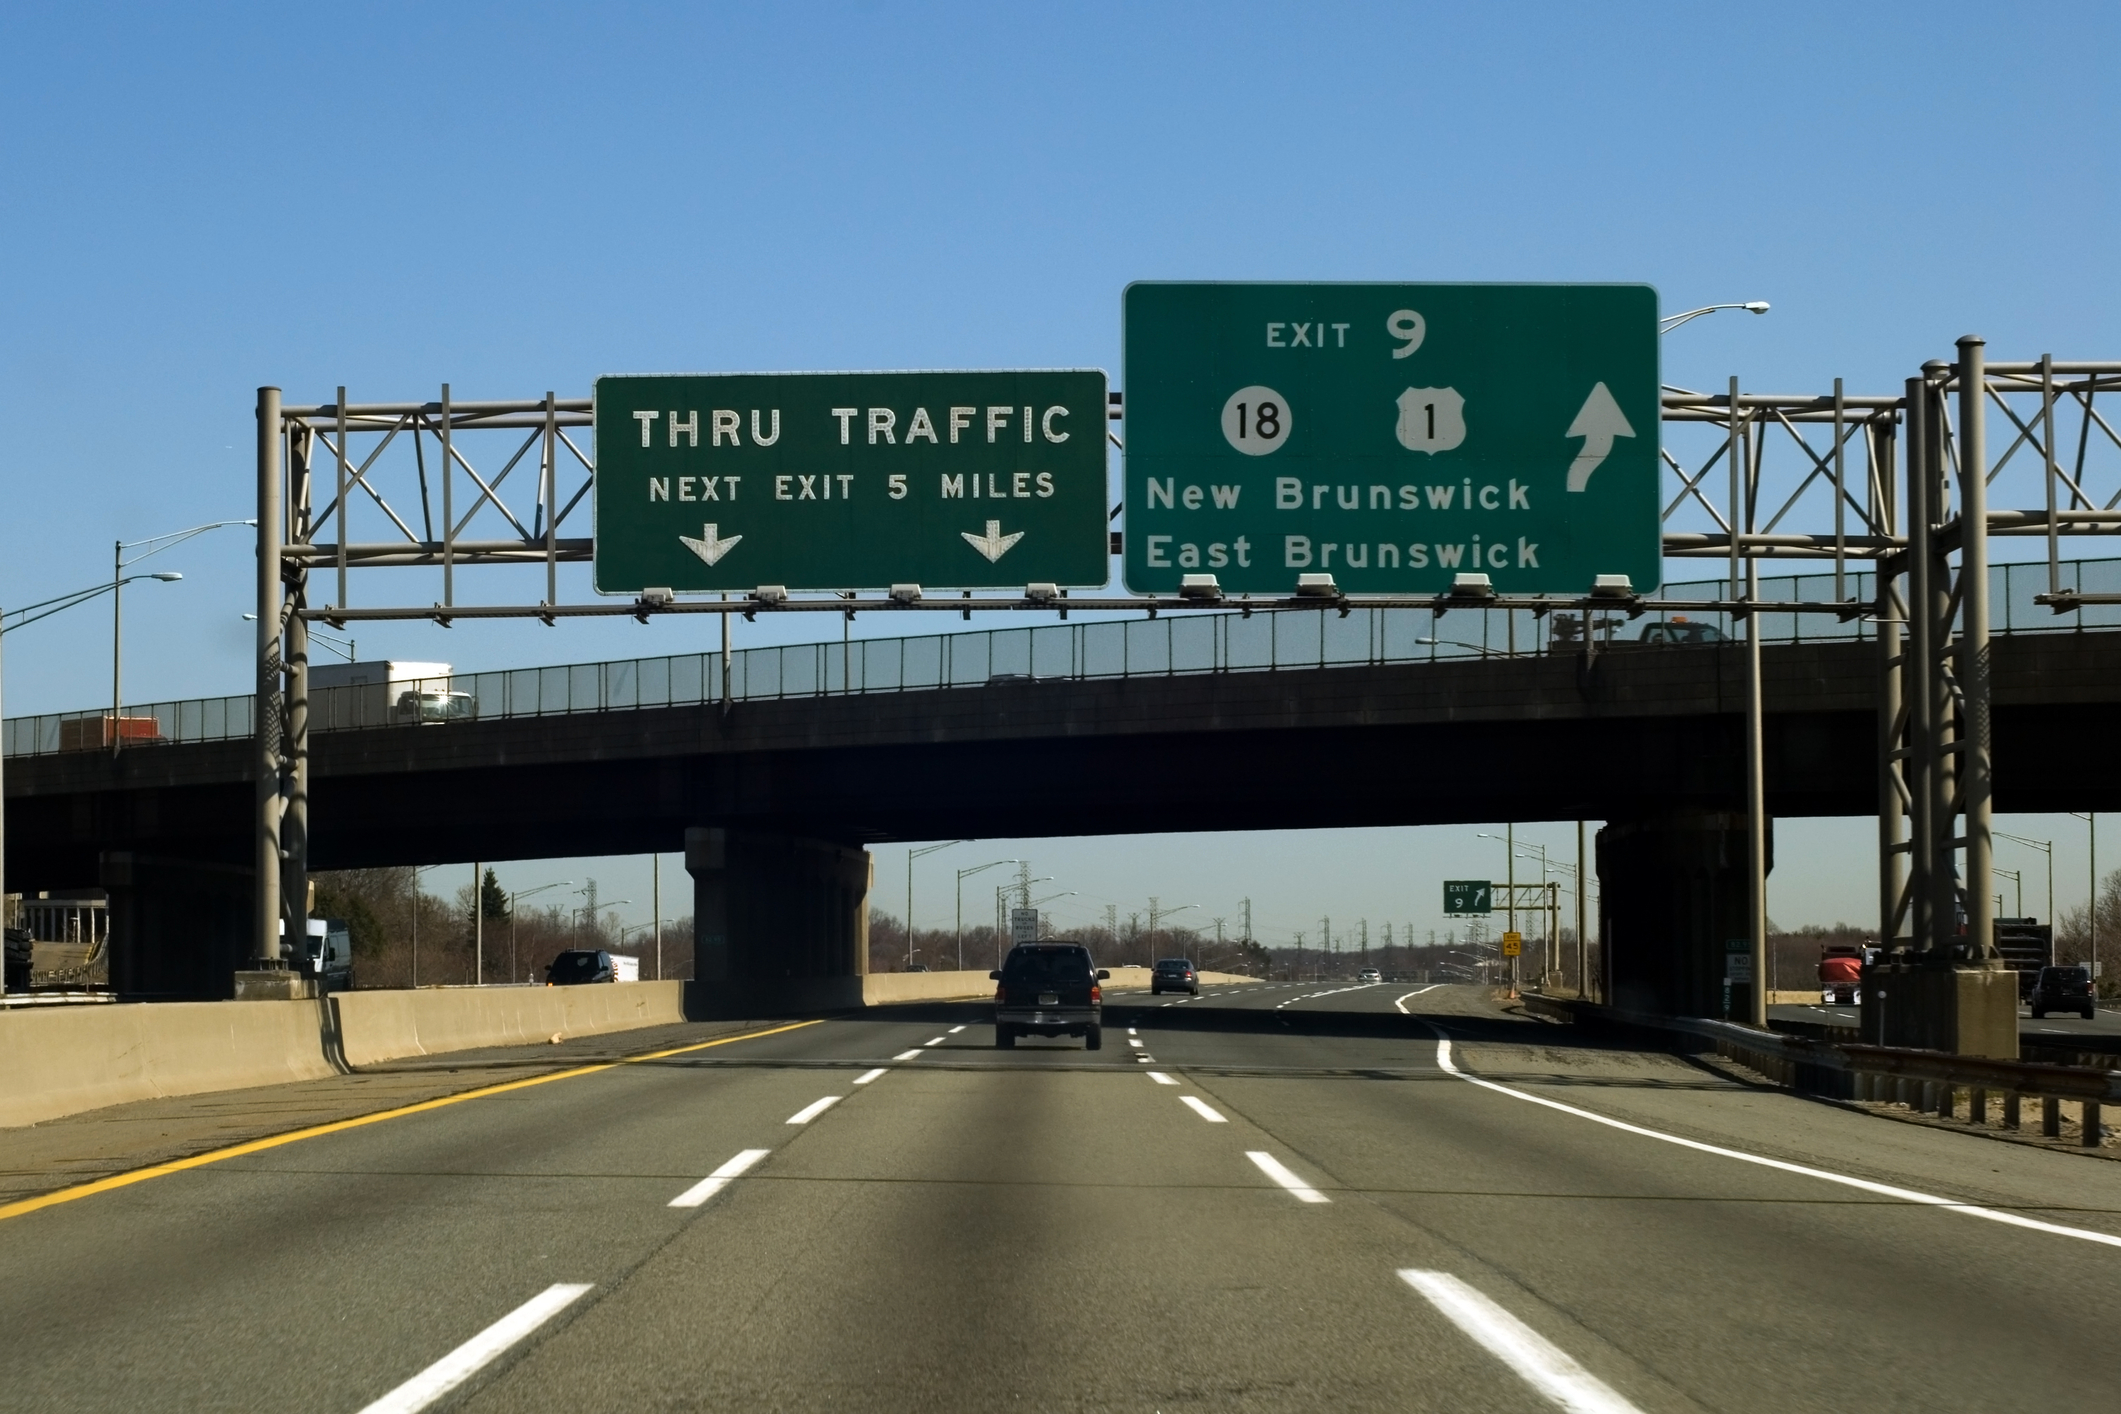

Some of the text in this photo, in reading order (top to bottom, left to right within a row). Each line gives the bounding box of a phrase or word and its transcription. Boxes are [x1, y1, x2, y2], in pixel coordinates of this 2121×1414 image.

[1266, 309, 1426, 359] EXIT 9
[633, 406, 1069, 447] THRU TRAFFIC
[1236, 401, 1280, 439] 18
[1424, 403, 1435, 440] 1
[651, 473, 1053, 501] NEXT EXIT 5 MILES
[1146, 476, 1531, 510] New Brunswick
[1146, 533, 1540, 569] East Brunswick
[1455, 898, 1463, 908] 9
[1734, 956, 1748, 965] NO
